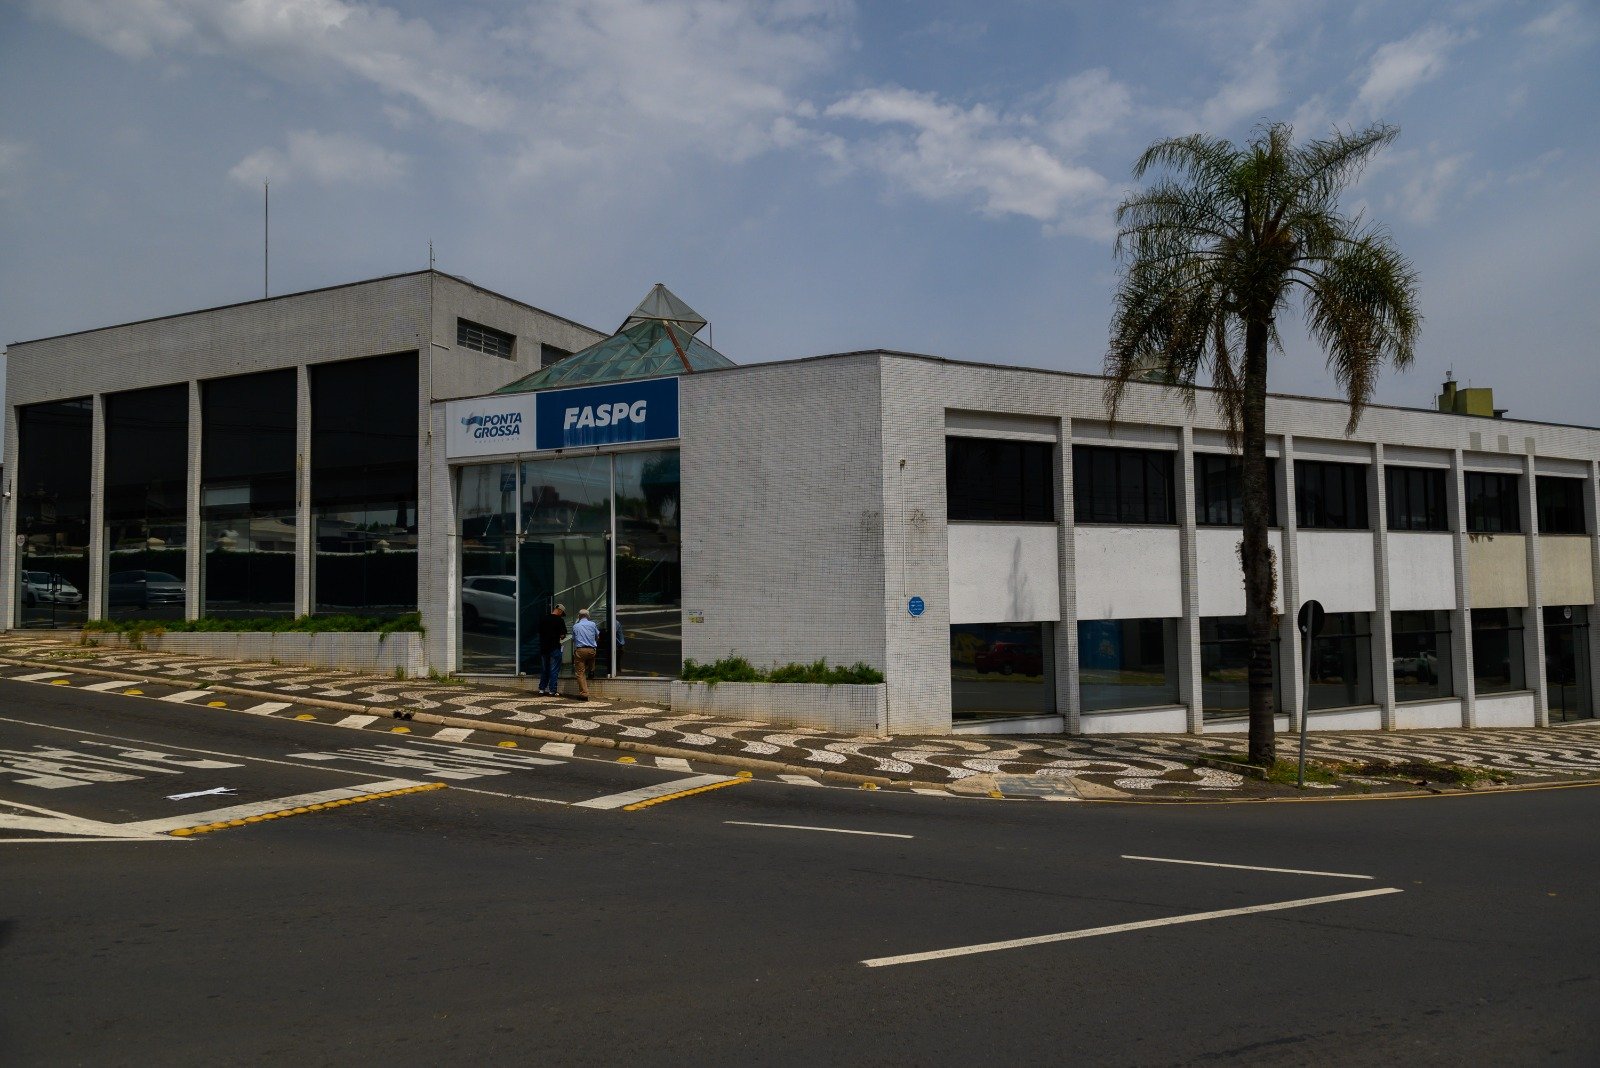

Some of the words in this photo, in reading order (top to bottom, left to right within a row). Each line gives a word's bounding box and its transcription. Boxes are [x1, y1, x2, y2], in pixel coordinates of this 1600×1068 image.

[483, 412, 522, 426] PONTA
[563, 400, 647, 430] FASPG
[474, 424, 520, 438] GROSSA
